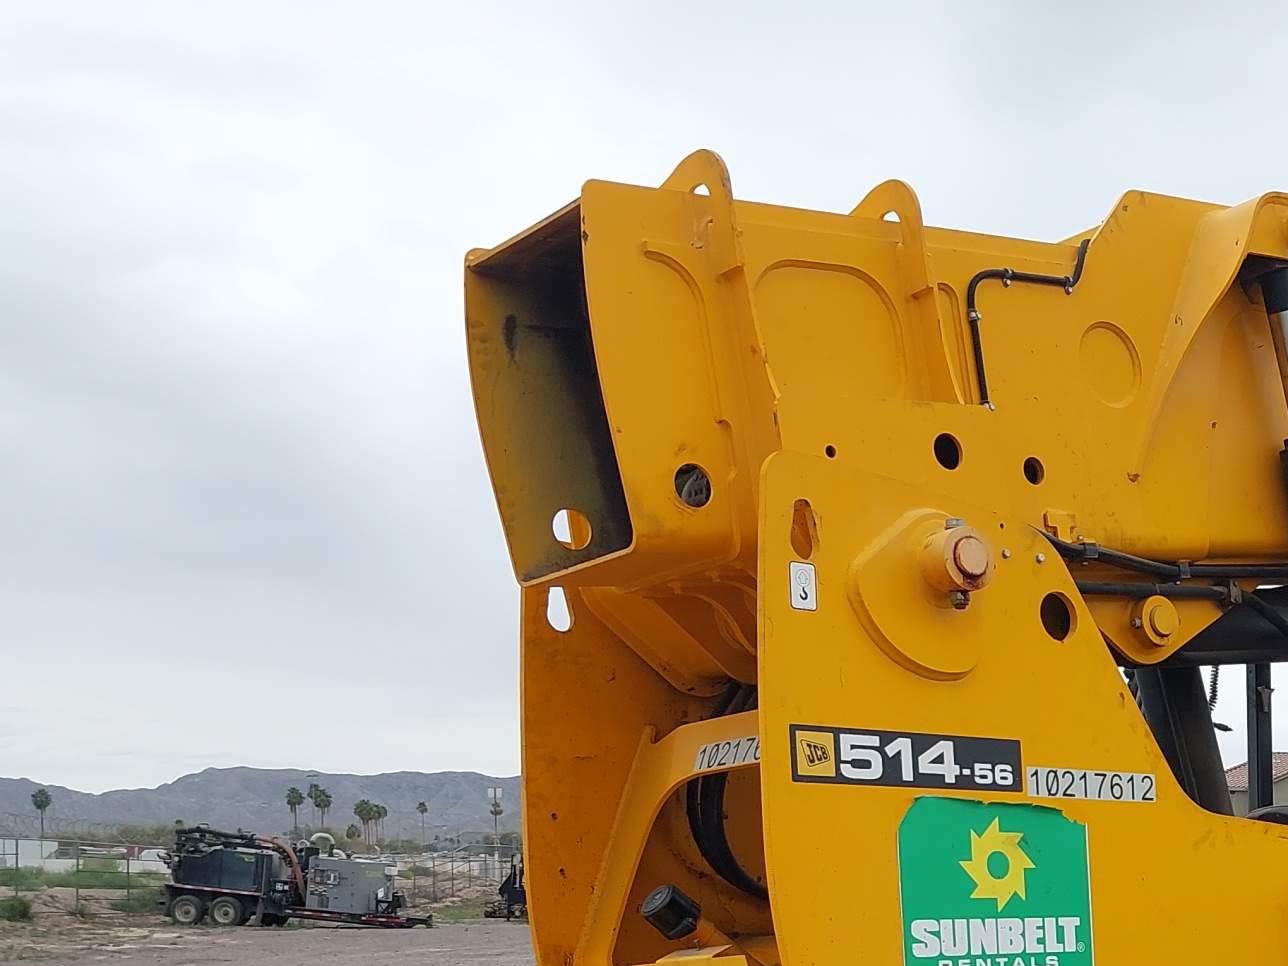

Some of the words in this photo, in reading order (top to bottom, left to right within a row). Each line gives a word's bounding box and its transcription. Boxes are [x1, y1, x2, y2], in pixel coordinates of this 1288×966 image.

[805, 742, 830, 765] JCB
[839, 733, 1014, 786] 514-56
[1029, 767, 1155, 802] 10217612
